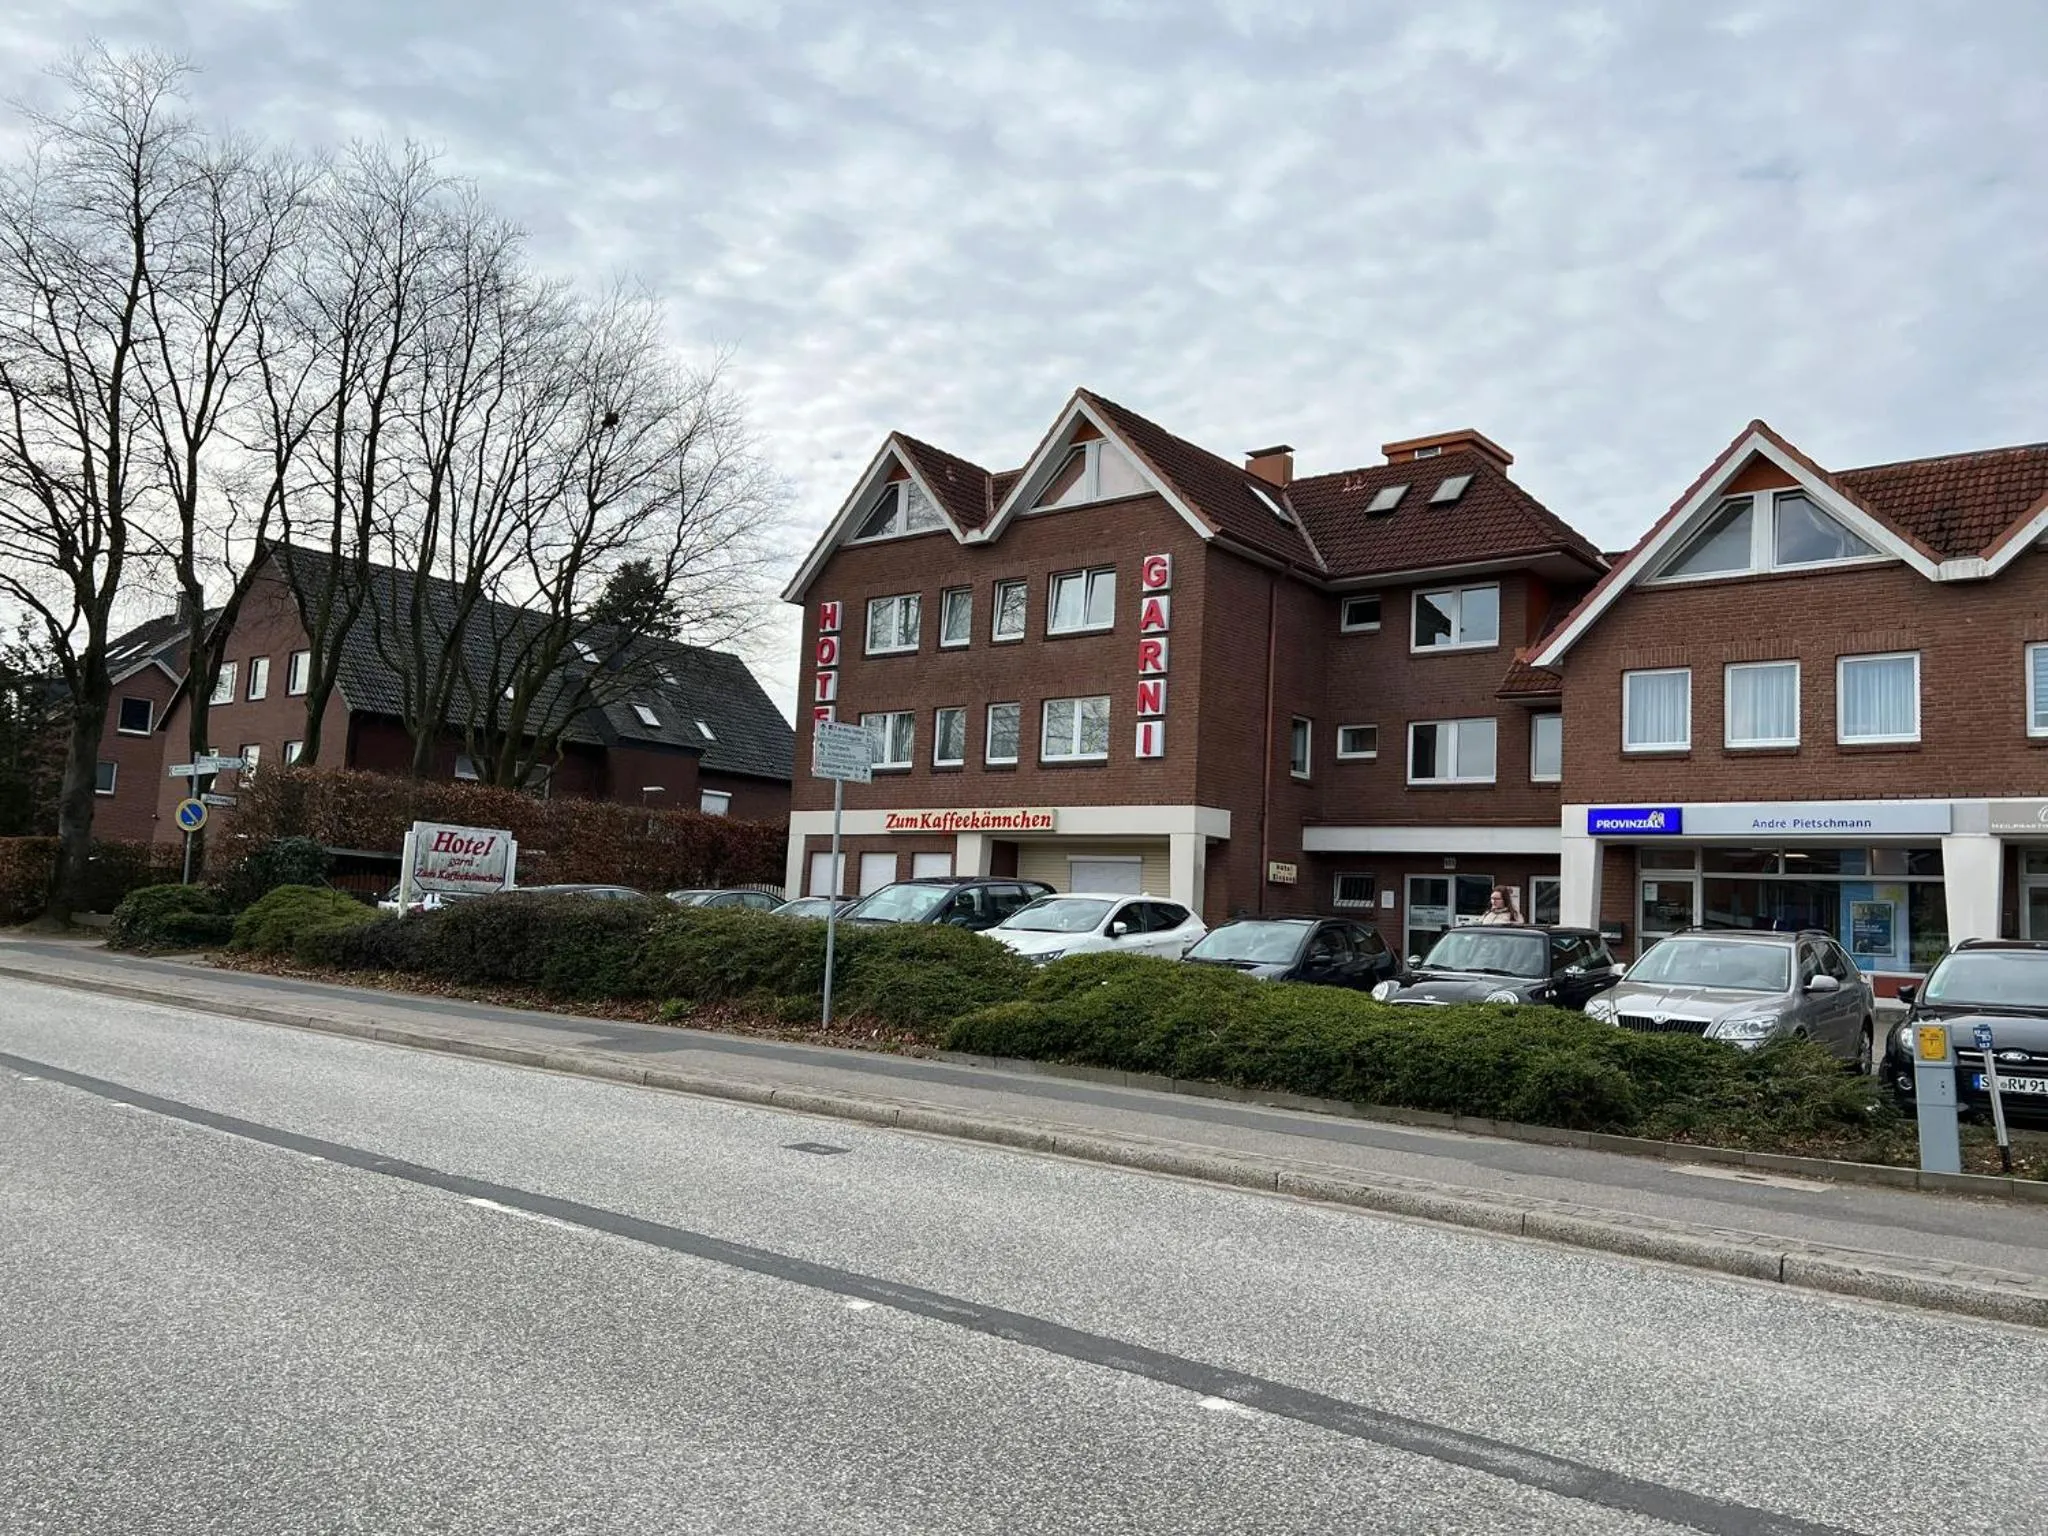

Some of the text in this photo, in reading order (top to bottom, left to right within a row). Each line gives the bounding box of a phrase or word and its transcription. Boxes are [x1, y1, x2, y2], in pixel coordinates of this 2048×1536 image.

[814, 603, 837, 721] HOTE
[1137, 556, 1168, 756] GARNI
[885, 810, 1052, 831] Zum Kaffeekännchen
[1596, 818, 1662, 829] PROVINZIAL
[1793, 818, 1872, 829] Pietschmann
[430, 831, 496, 857] Hotel
[2008, 1078, 2027, 1091] RW
